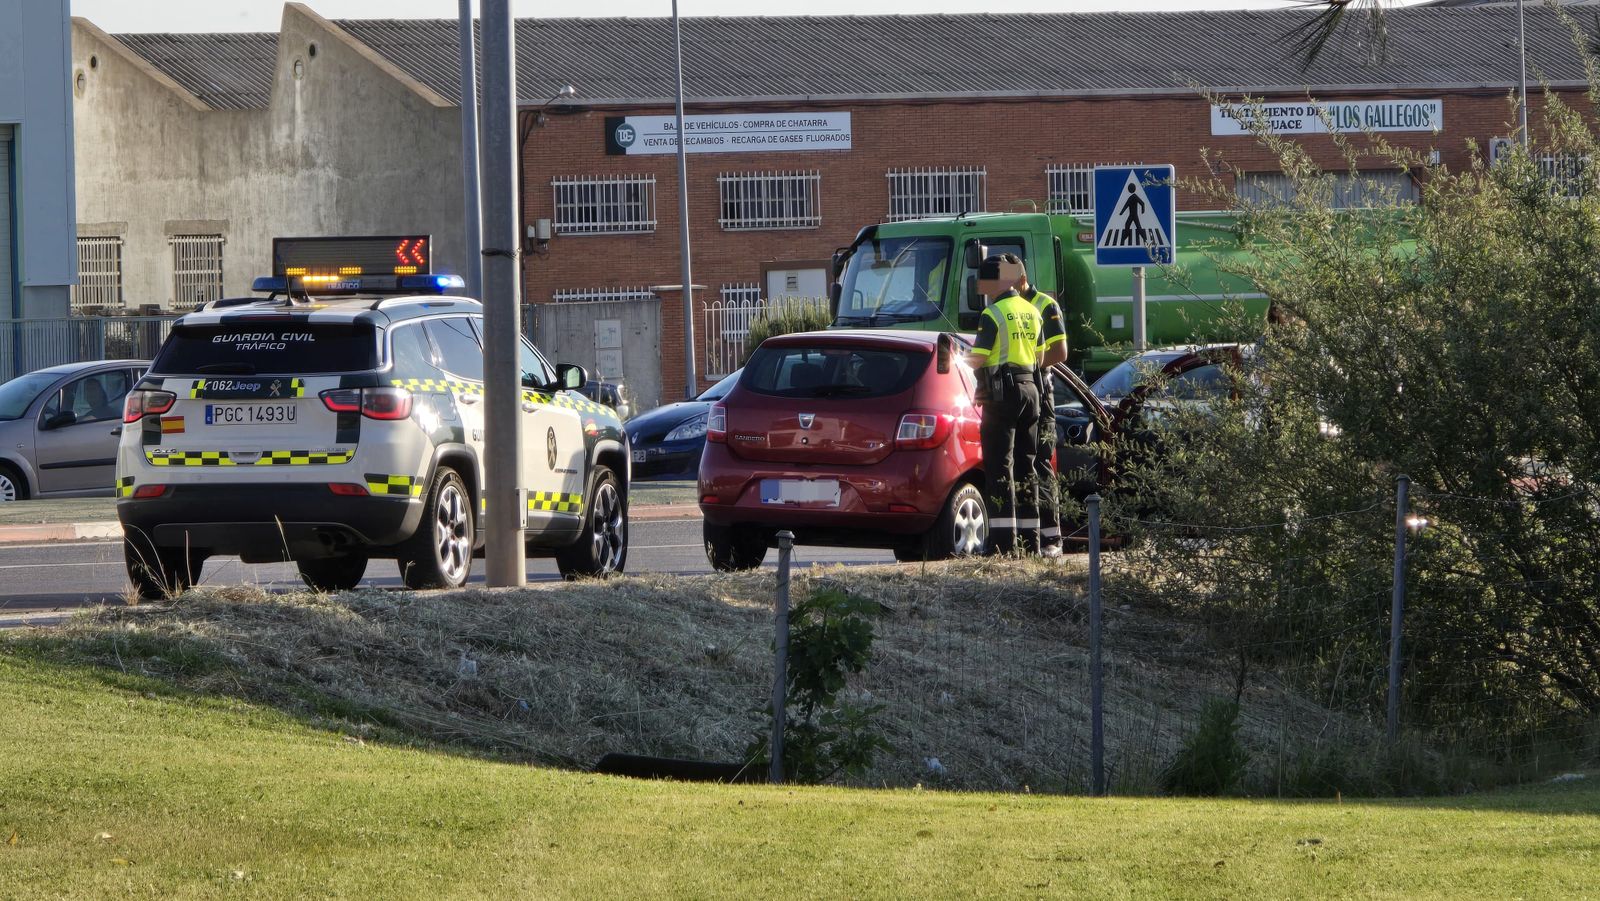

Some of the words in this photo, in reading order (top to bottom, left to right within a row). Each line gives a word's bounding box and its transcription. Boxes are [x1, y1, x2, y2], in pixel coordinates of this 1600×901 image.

[684, 121, 695, 131] DE
[743, 120, 775, 129] COMPRA
[776, 119, 787, 128] DE
[788, 119, 828, 128] CHATARRA
[643, 138, 668, 147] VENTA
[683, 136, 724, 146] ECAMBIOS
[731, 135, 767, 144] RECARGA
[768, 135, 778, 144] DE
[779, 134, 804, 143] GASES
[805, 133, 850, 142] FLUORADOS
[212, 332, 275, 343] GUARDIA
[281, 332, 315, 342] CIVIL
[235, 341, 286, 351] TRÁFICO
[212, 380, 233, 391] 062
[232, 381, 261, 392] Jeep
[214, 407, 243, 423] PGC
